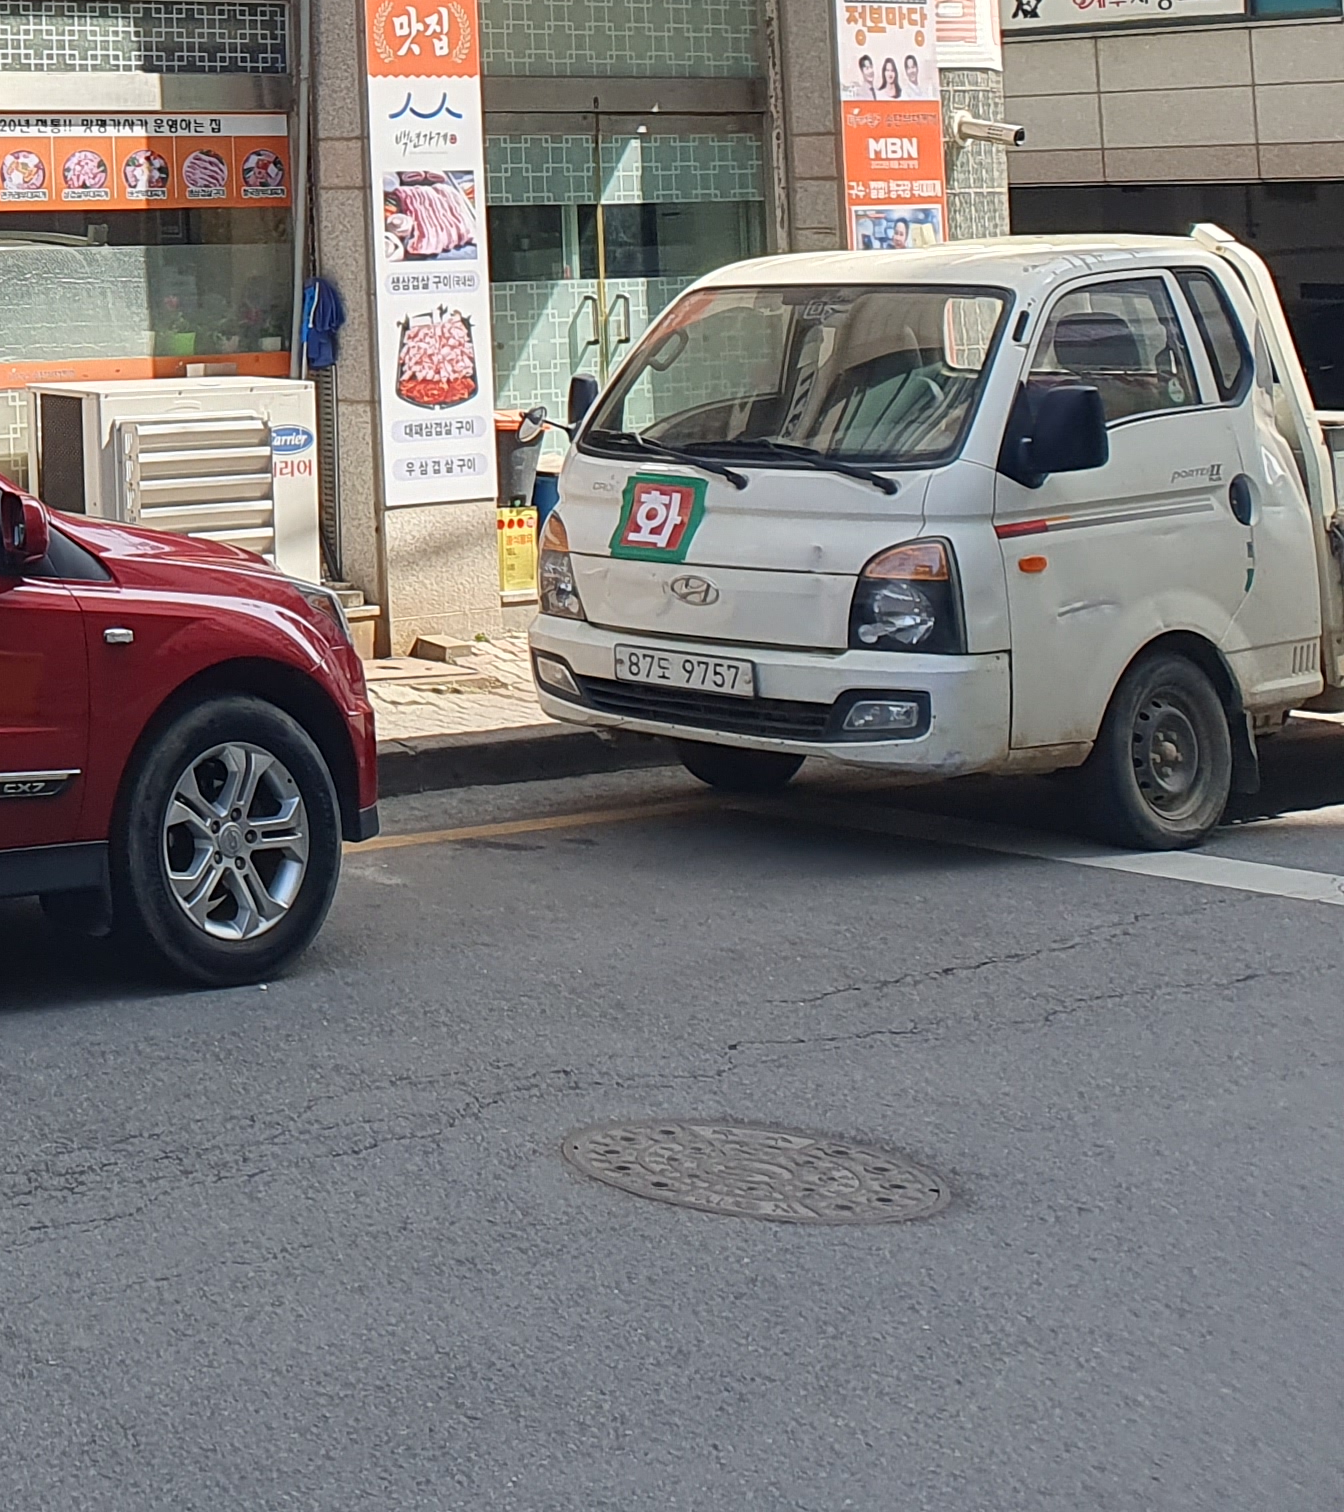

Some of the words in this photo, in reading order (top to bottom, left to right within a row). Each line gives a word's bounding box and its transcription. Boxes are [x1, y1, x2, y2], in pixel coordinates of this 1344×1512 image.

[392, 5, 450, 57] 맛집
[845, 5, 928, 47] 정보마당
[35, 118, 72, 134] 전통!!
[209, 118, 221, 134] 집
[868, 137, 919, 160] MBN
[390, 273, 430, 292] 생삼겹살
[404, 421, 453, 438] 대패삼겹살
[455, 418, 475, 435] 구이
[456, 457, 477, 474] 구이
[627, 490, 683, 548] 화
[628, 651, 671, 680] 87도
[682, 659, 740, 690] 9757
[3, 782, 46, 794] CX7
